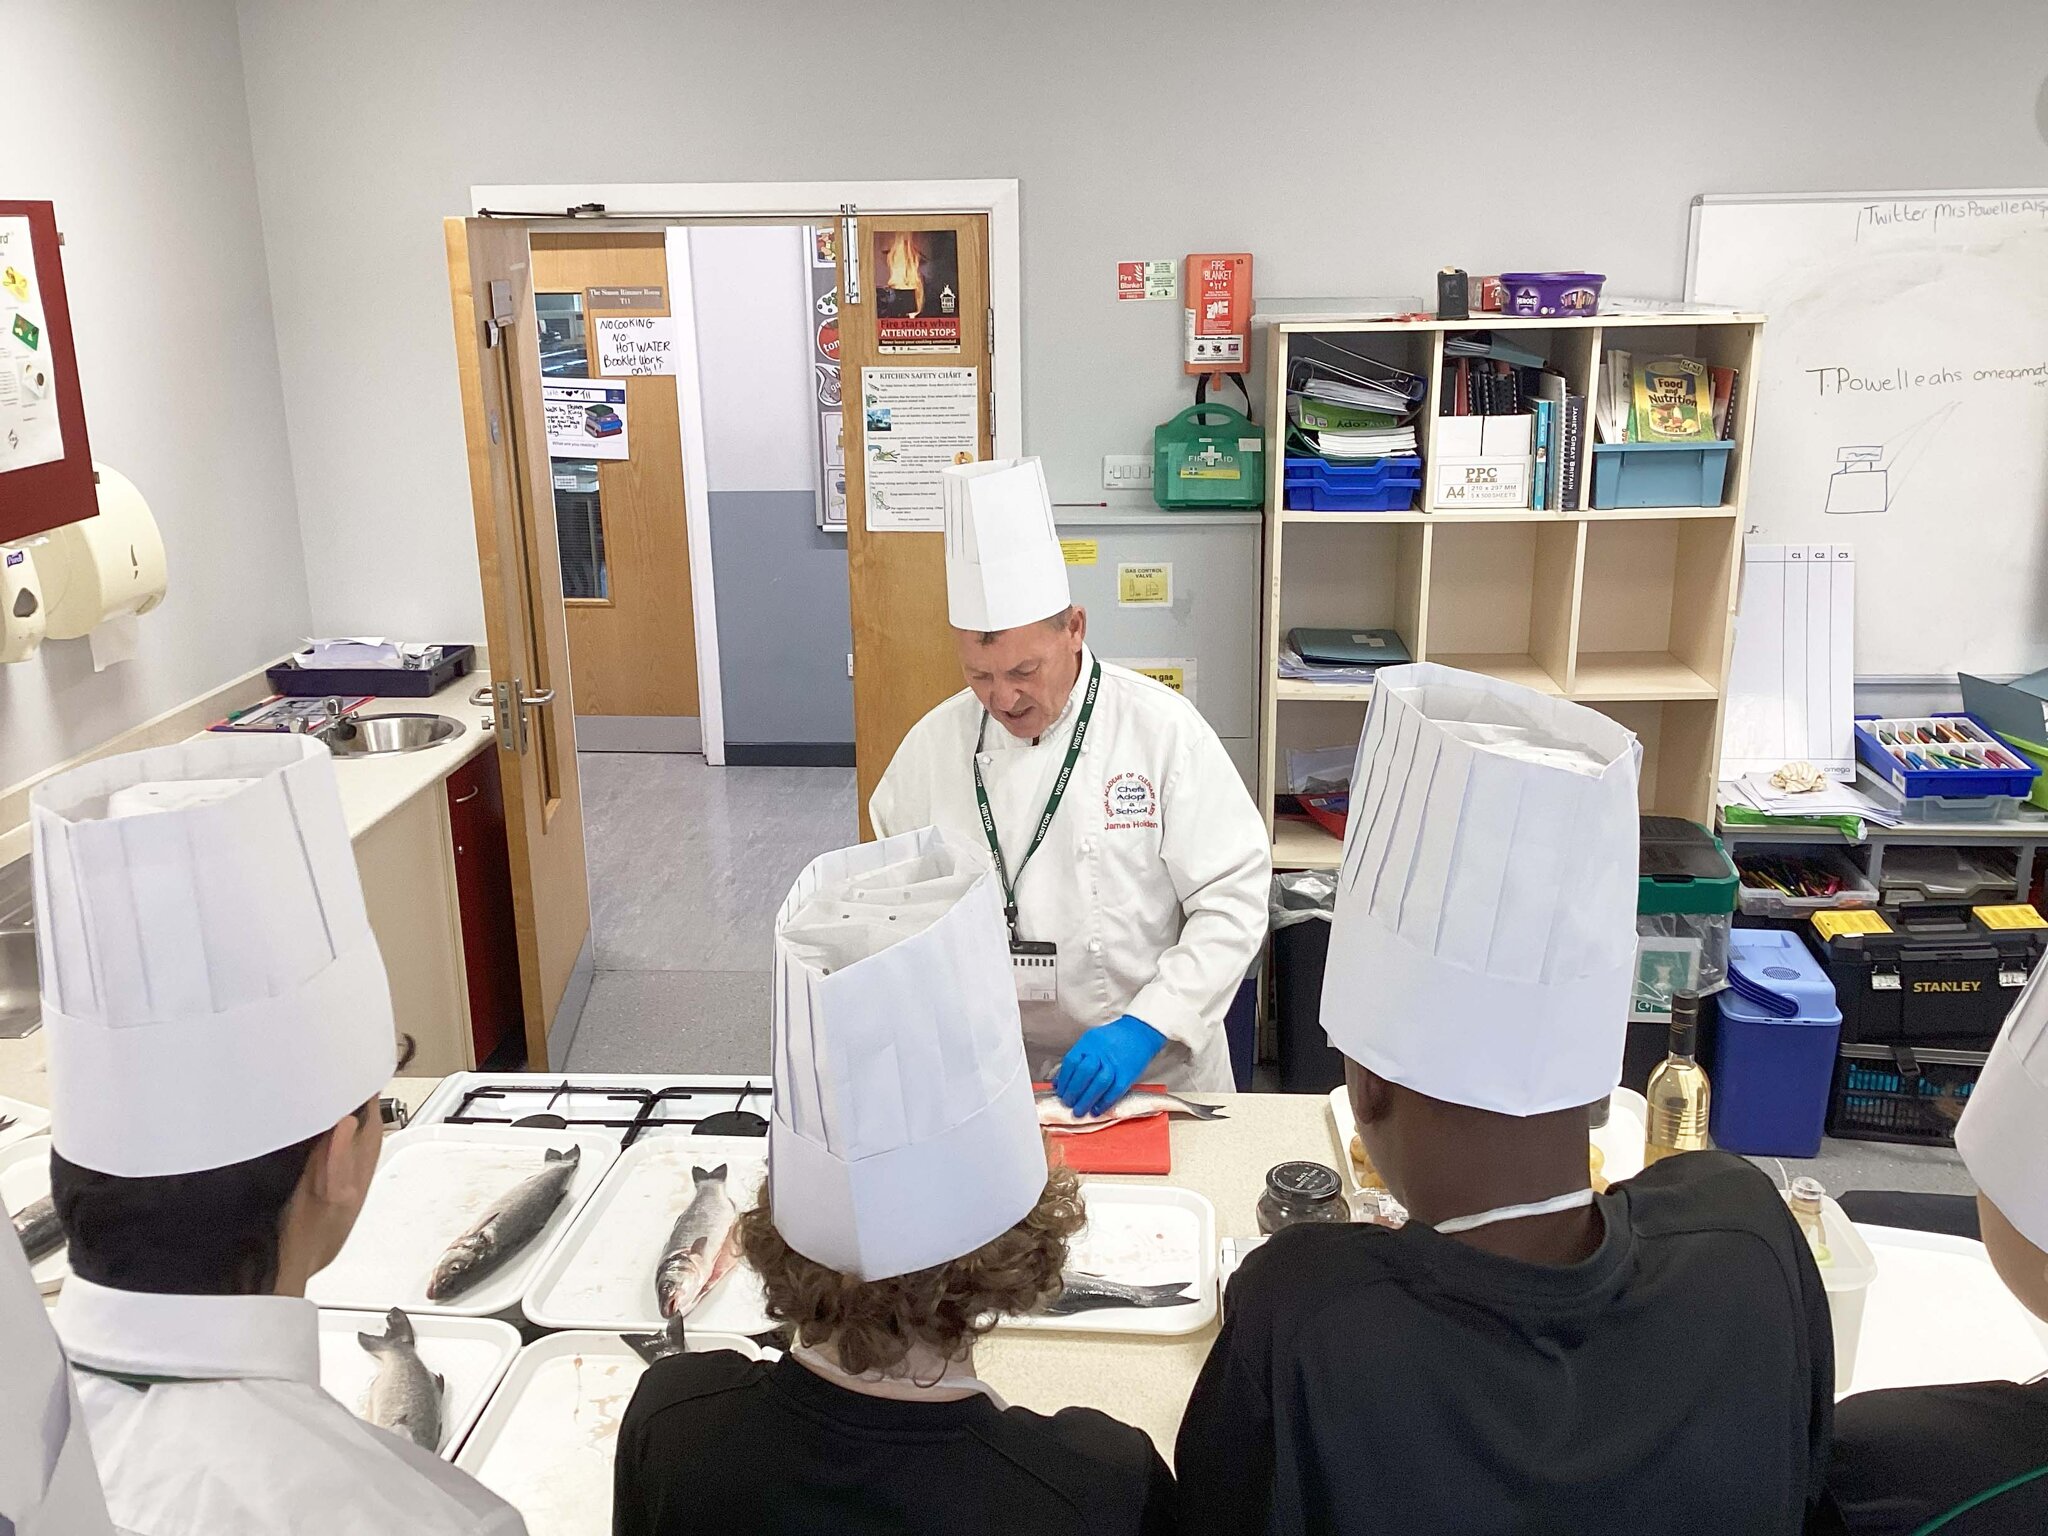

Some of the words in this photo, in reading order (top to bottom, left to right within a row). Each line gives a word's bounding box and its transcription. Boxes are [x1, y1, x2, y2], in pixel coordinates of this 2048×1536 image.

[1864, 204, 1927, 225] Twitter
[1211, 260, 1225, 270] FIRE
[1204, 270, 1232, 280] BLANKET
[589, 288, 600, 297] The
[600, 320, 613, 330] NO
[881, 319, 899, 329] Fire
[901, 319, 928, 329] starts
[930, 319, 956, 328] when
[612, 333, 626, 342] NO
[881, 328, 928, 337] ATTENTION
[929, 328, 956, 337] STOPS
[616, 341, 634, 353] HOT
[636, 340, 671, 353] WATER
[604, 354, 636, 368] Booklet
[880, 372, 910, 380] KITCHEN
[938, 371, 962, 379] CHART
[1658, 379, 1683, 390] Food
[1664, 388, 1678, 396] and
[1648, 394, 1698, 408] Nutrition
[1465, 467, 1498, 479] PPC
[1568, 461, 1576, 490] BRITAIN
[1446, 486, 1465, 498] A4
[1158, 674, 1173, 682] gas
[1086, 677, 1099, 704] VISITOR
[1072, 721, 1086, 750] VISITOR
[1054, 766, 1071, 796] VISITOR
[1104, 774, 1123, 798] ACADEMY
[1137, 774, 1156, 799] CULINARY
[1115, 806, 1148, 815] School
[980, 802, 993, 832] VISITOR
[1035, 812, 1051, 842] VISITOR
[1104, 822, 1131, 831] James
[1132, 820, 1158, 829] Holden
[1913, 981, 1981, 992] STANLEY
